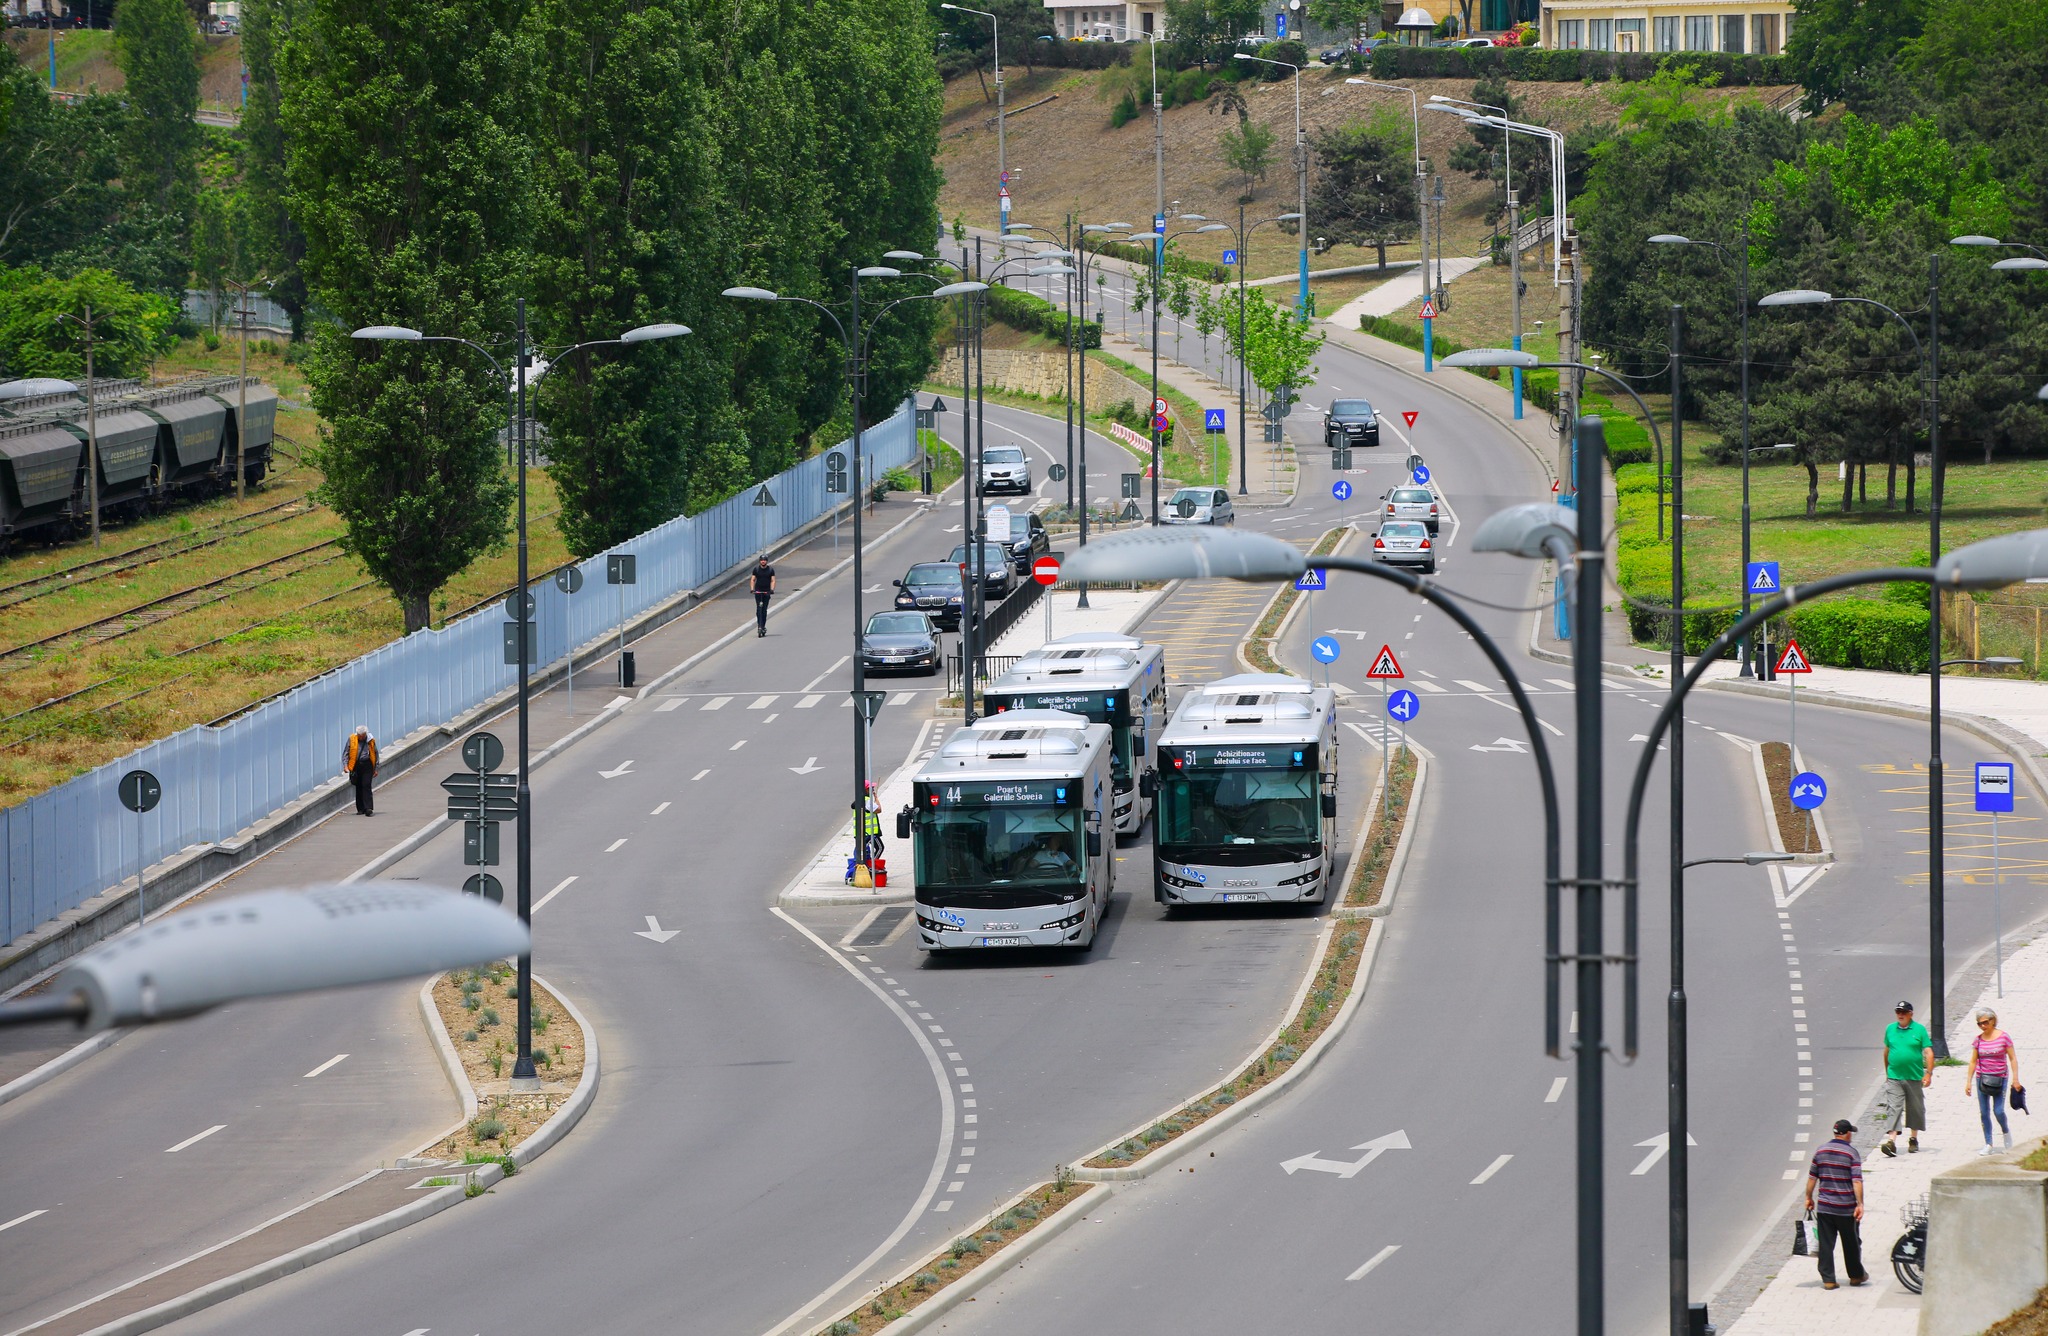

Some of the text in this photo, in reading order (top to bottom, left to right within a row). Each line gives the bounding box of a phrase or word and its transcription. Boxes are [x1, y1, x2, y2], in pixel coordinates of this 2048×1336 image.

[1012, 698, 1025, 710] 44
[1185, 750, 1197, 765] 51
[1213, 757, 1241, 765] biletului
[997, 785, 1028, 793] Poarta 1
[946, 786, 962, 803] 44
[1223, 879, 1258, 887] ISUZU
[983, 922, 1019, 931] ISUZU
